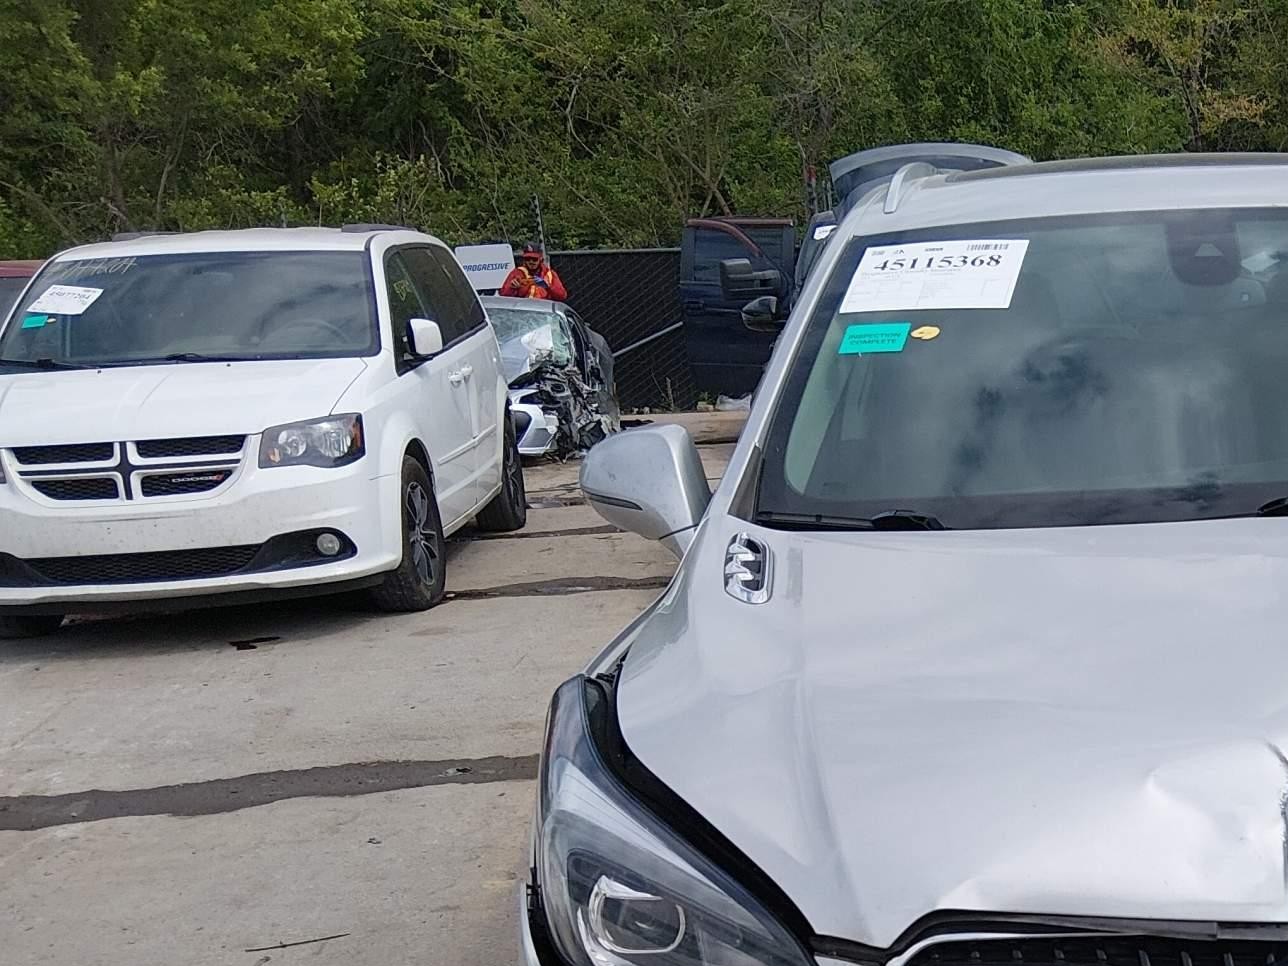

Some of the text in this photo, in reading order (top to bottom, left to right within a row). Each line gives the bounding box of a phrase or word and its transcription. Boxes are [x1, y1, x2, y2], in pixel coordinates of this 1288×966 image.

[873, 254, 1003, 271] 45115368
[463, 263, 510, 272] PROGRESSIVE
[848, 332, 902, 340] INSPECTION
[849, 338, 898, 346] COMPLETE
